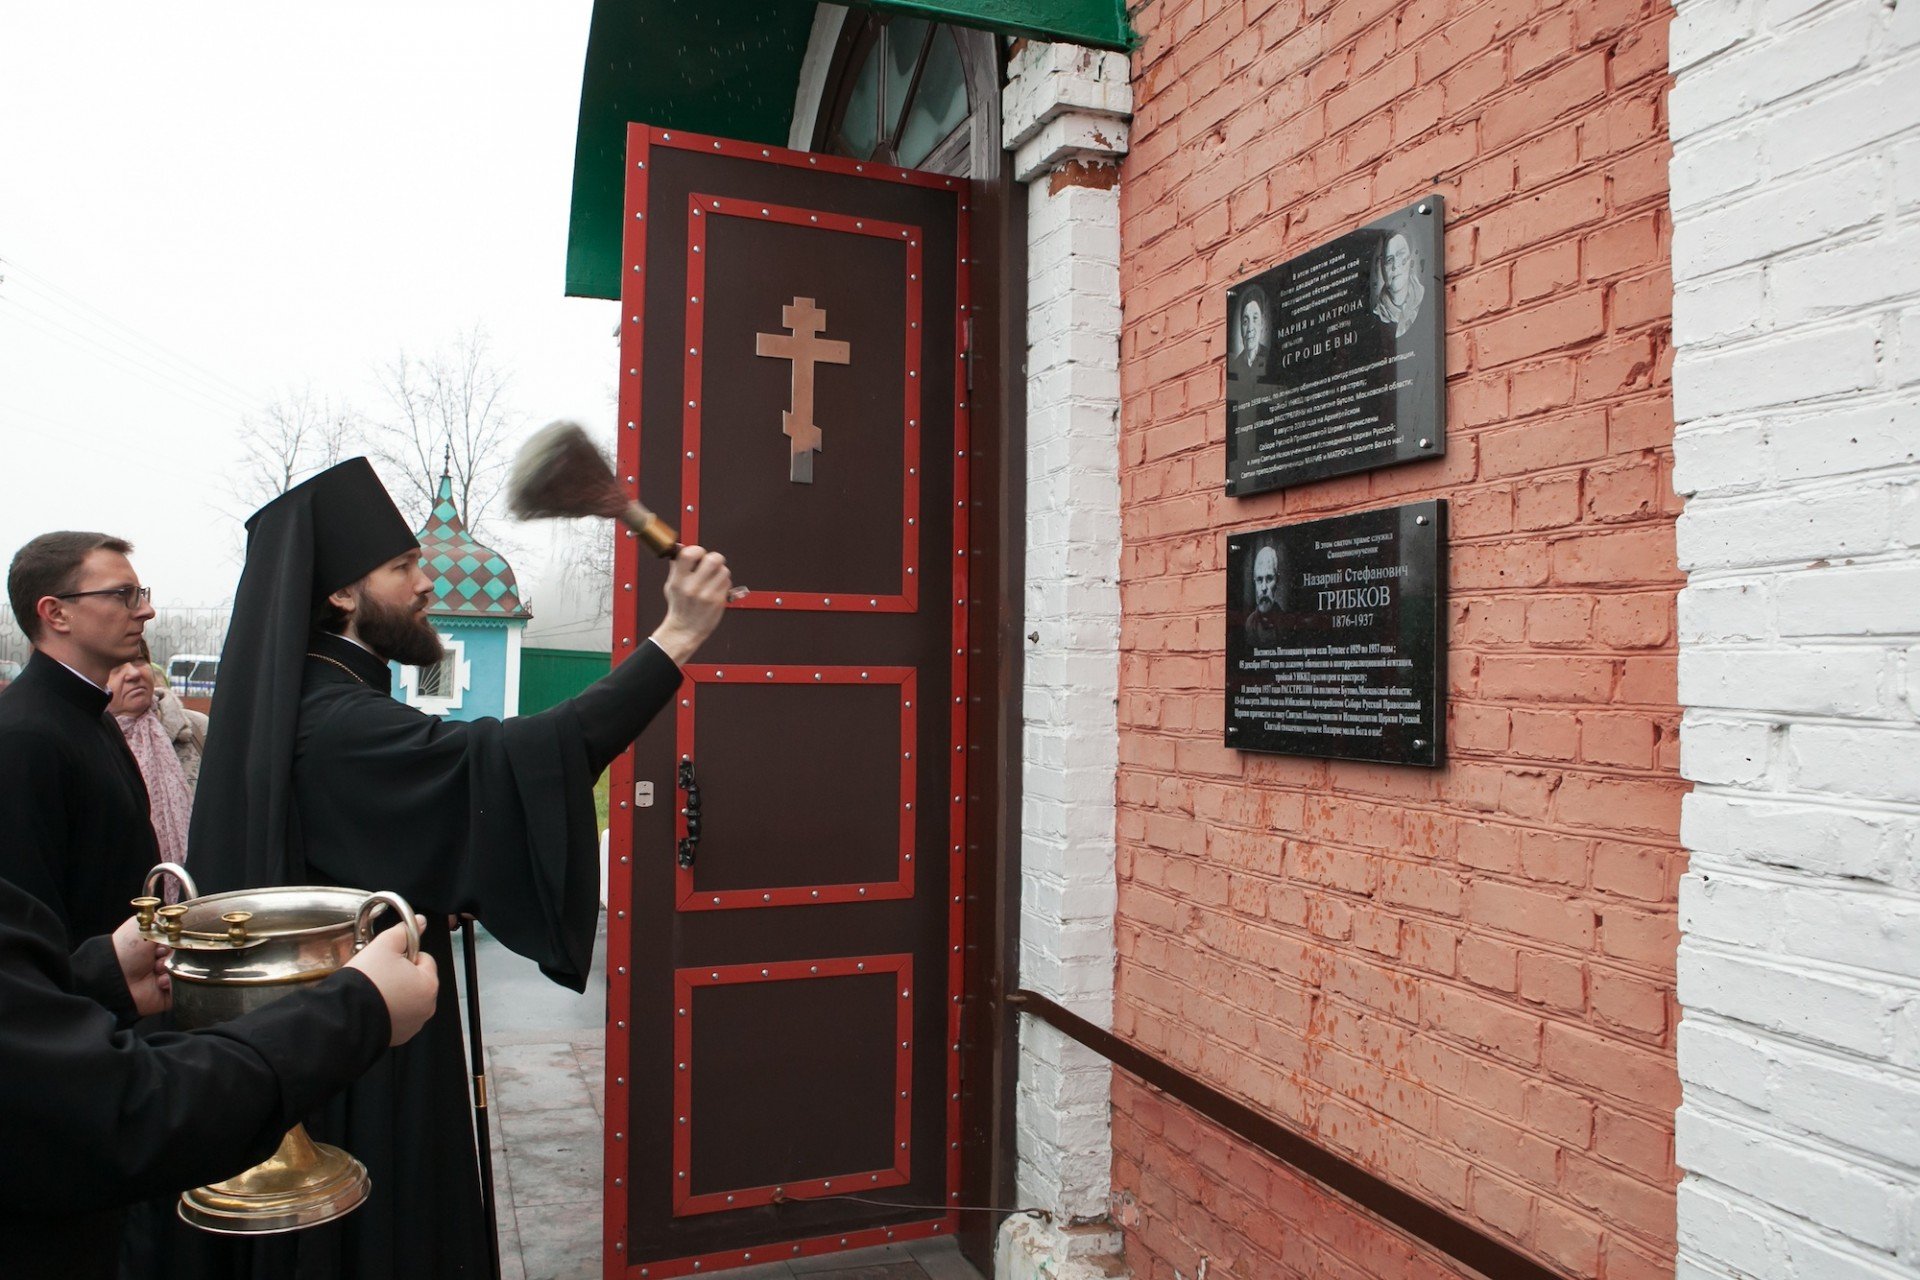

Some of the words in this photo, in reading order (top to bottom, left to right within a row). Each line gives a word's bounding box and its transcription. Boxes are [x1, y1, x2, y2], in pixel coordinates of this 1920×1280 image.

[1310, 261, 1328, 273] святом
[1329, 253, 1345, 264] храме
[1320, 272, 1329, 280] лет
[1330, 265, 1346, 276] несли
[1278, 320, 1307, 338] МАРИЯ
[1319, 299, 1363, 323] МАТРОНА
[1282, 330, 1357, 368] (ГРОШЕВЫ)
[1333, 539, 1352, 547] святом
[1303, 569, 1342, 589] Назарий
[1345, 565, 1408, 584] Стефанович
[1318, 586, 1390, 611] ГРИБКОВ
[1333, 613, 1373, 628] 1876-1937
